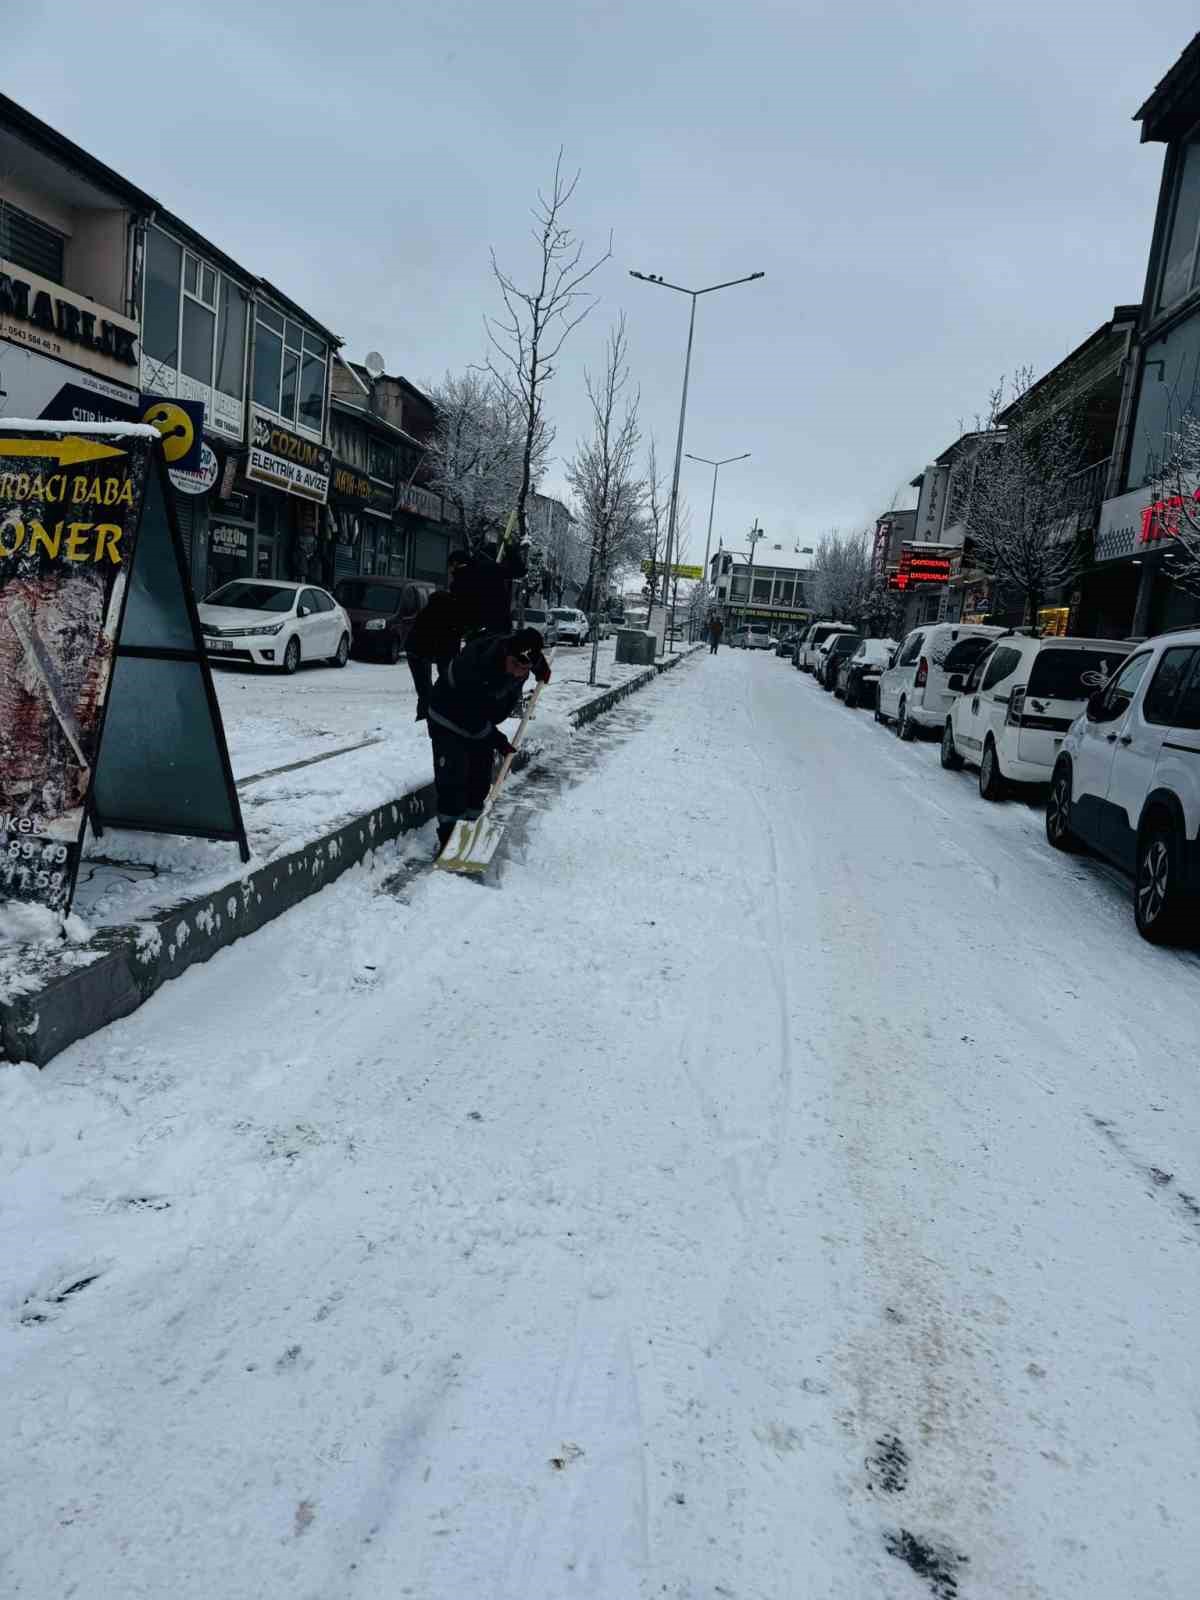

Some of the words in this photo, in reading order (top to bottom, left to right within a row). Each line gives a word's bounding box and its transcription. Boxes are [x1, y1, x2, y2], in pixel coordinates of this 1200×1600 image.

[296, 470, 304, 482] &
[71, 475, 134, 506] BABA
[8, 840, 34, 860] 89
[42, 843, 68, 864] 49
